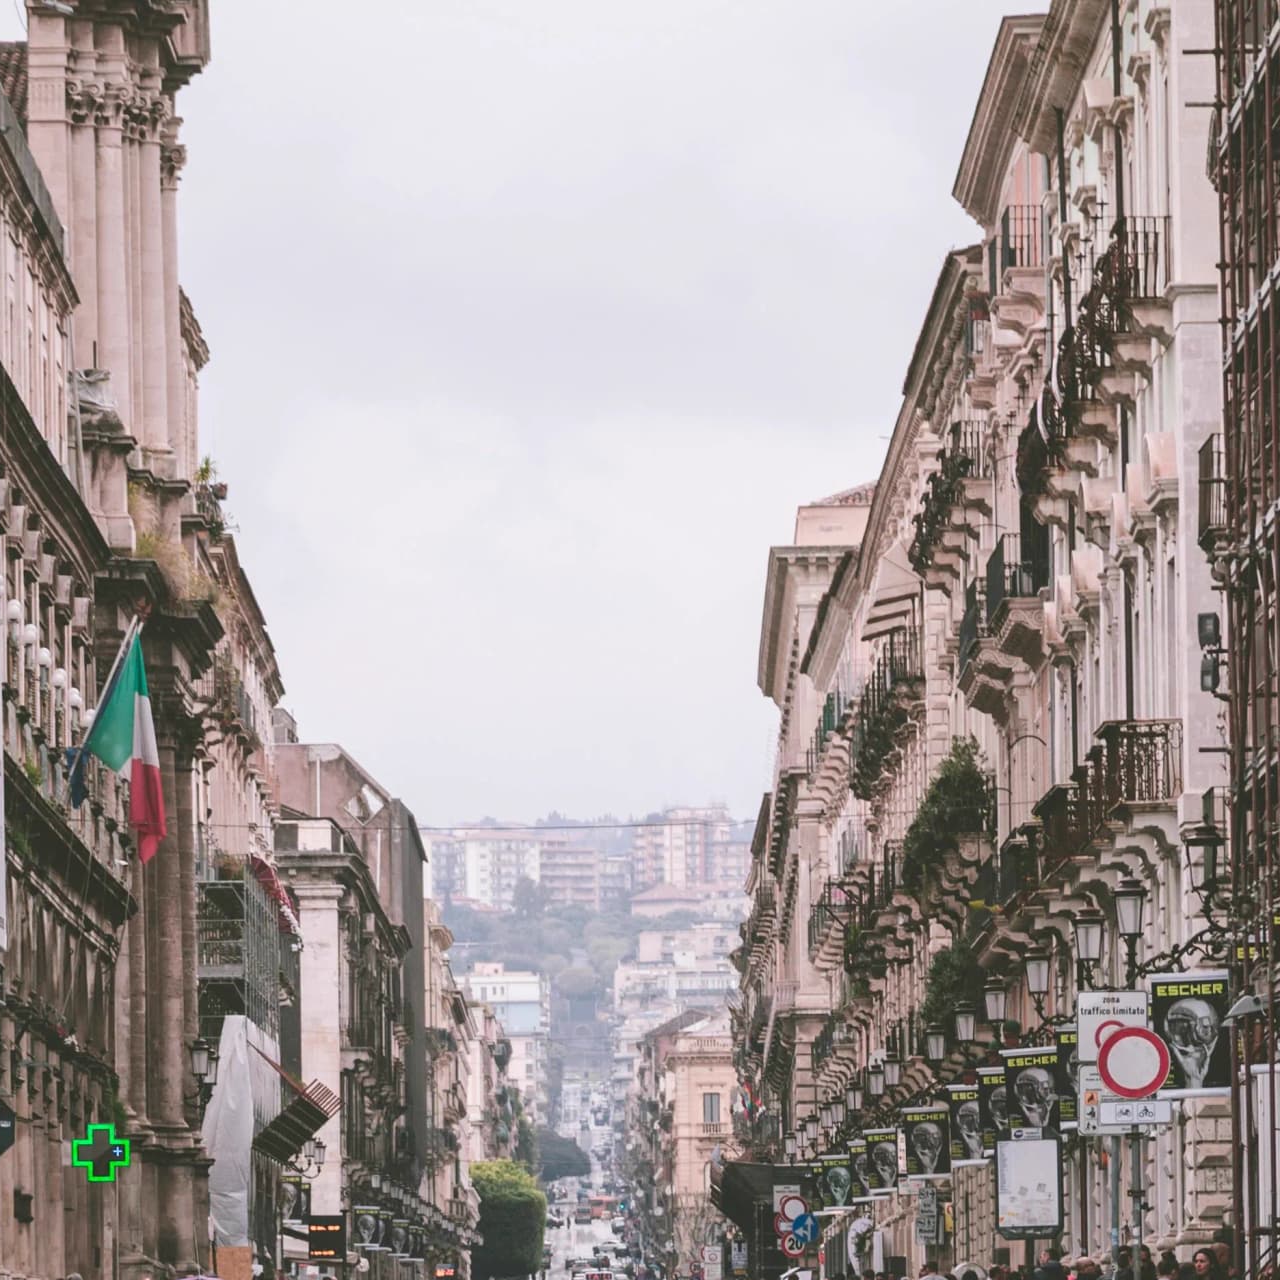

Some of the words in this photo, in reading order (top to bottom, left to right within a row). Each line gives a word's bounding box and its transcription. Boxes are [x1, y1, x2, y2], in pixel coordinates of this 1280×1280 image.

[1156, 983, 1223, 997] ESCHER
[1080, 1006, 1111, 1016] traffico
[1112, 1006, 1145, 1015] limitato
[1007, 1055, 1058, 1067] ESCHER
[907, 1113, 946, 1121] ESCHER
[788, 1238, 803, 1250] 20
